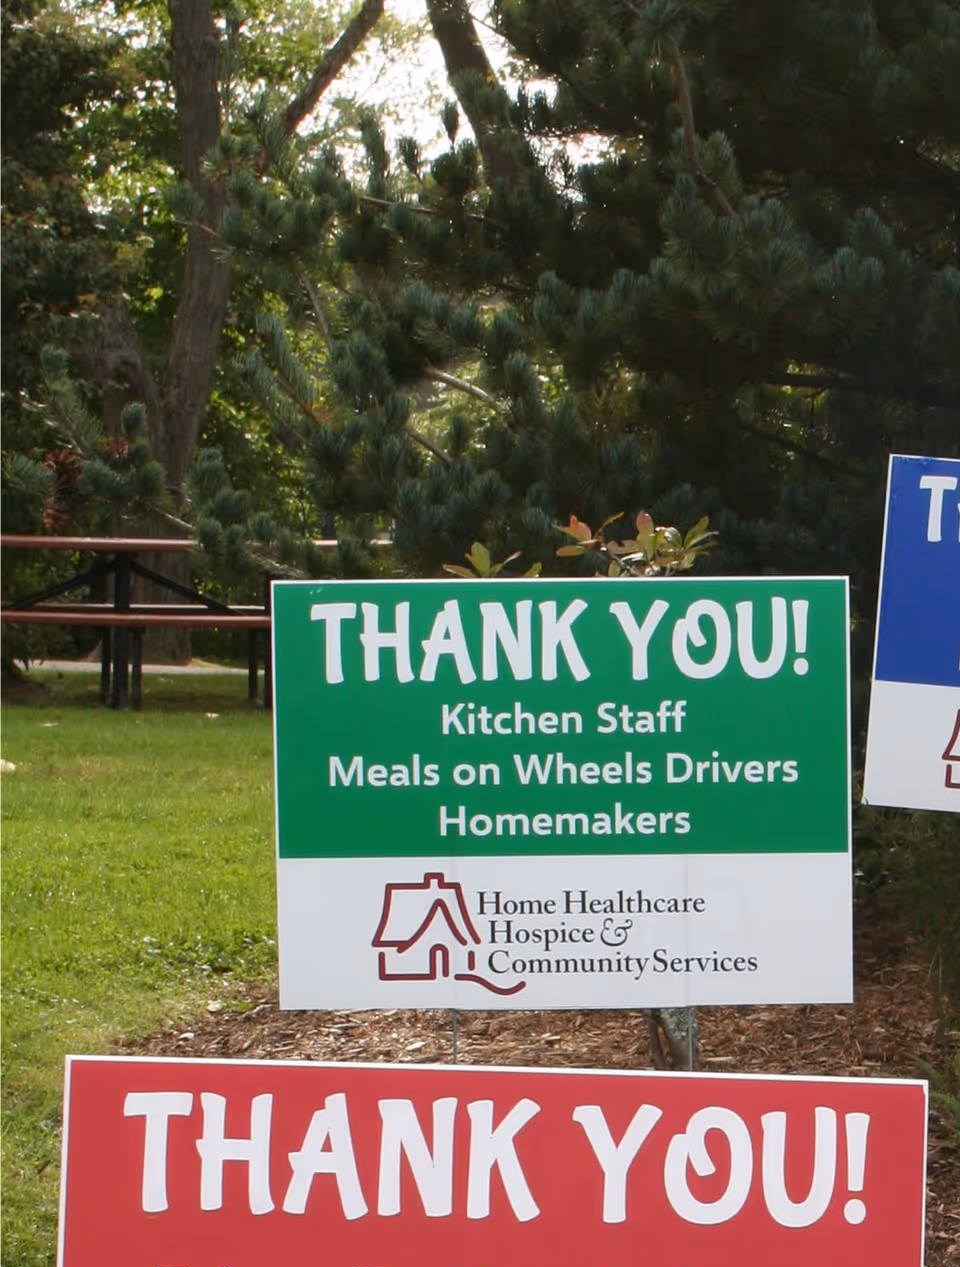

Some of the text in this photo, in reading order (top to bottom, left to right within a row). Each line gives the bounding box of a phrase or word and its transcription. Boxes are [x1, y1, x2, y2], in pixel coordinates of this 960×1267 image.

[310, 597, 809, 684] THANK YOU!
[442, 700, 686, 734] Kitchen Staff
[329, 751, 798, 786] Meals on Wheels Drivers
[440, 802, 690, 836] Homemakers
[477, 890, 705, 914] Home Healthcare
[488, 918, 633, 951] Hospice &
[488, 949, 757, 980] Community Services
[124, 1092, 870, 1227] THANK YOU!
